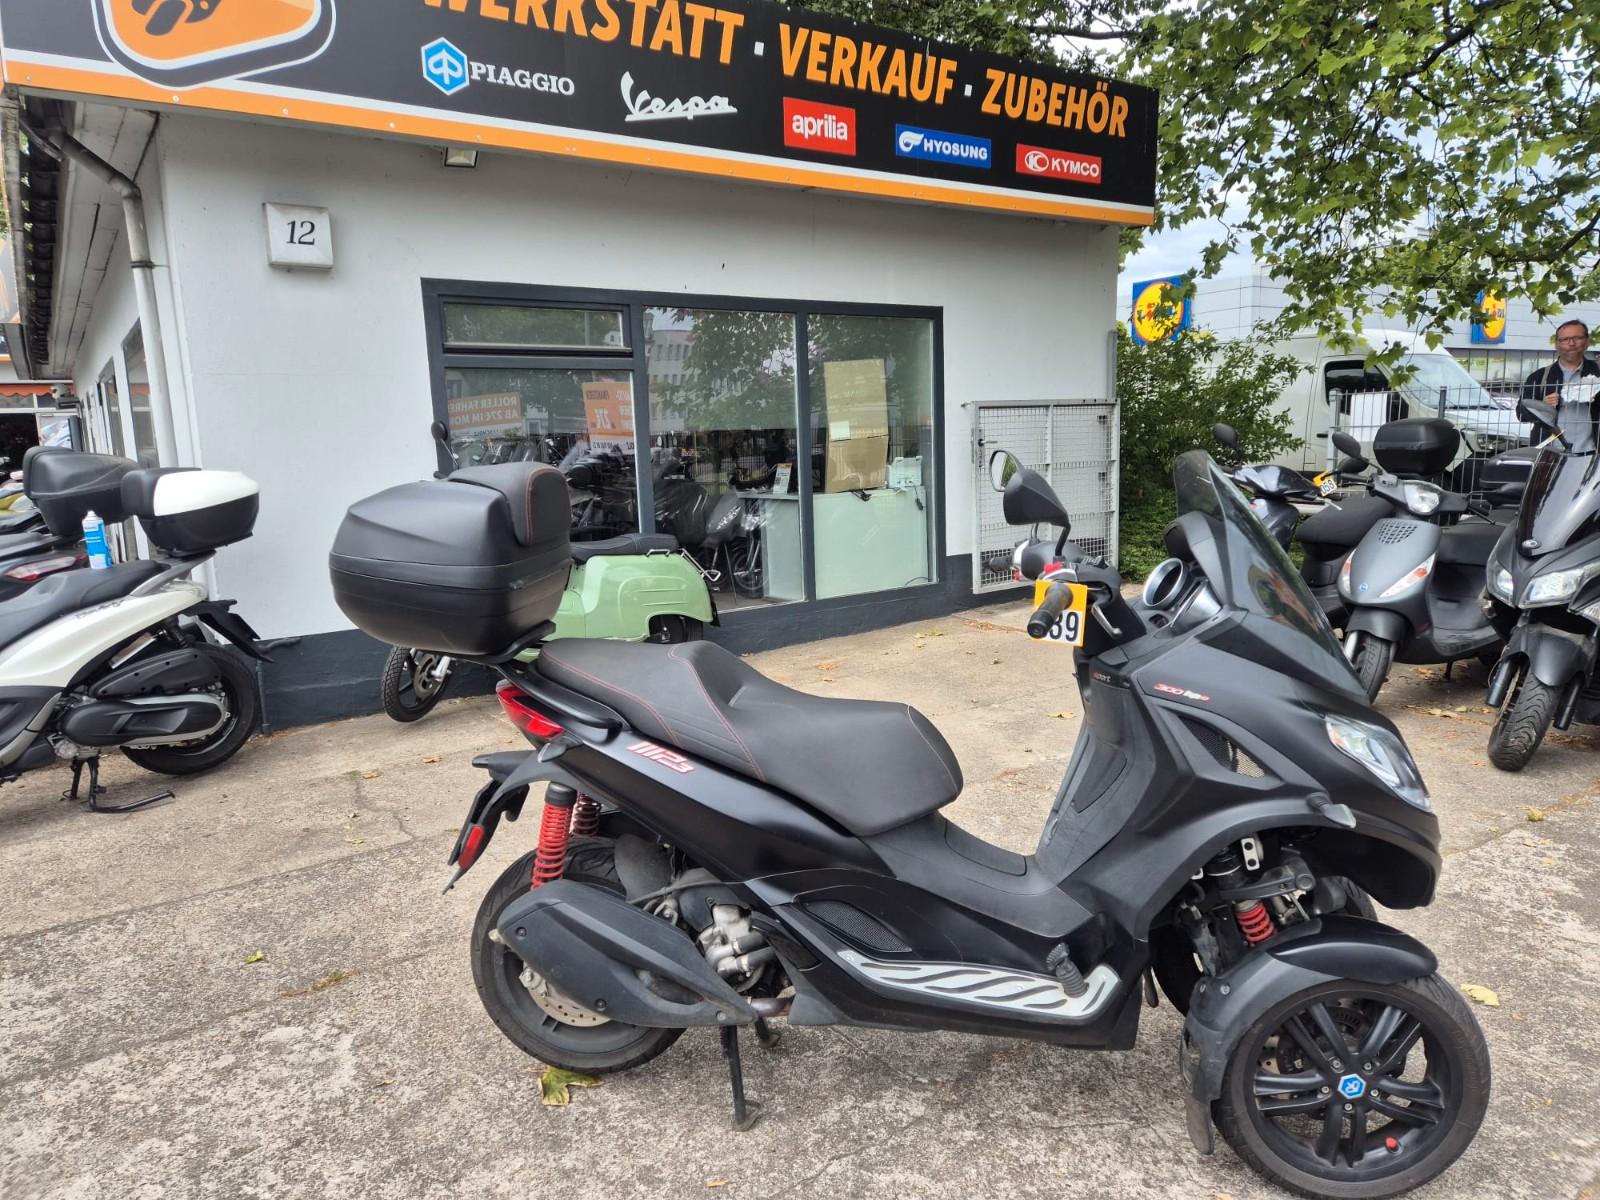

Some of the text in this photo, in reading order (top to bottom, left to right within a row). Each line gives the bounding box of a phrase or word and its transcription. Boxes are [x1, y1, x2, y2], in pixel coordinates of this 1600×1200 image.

[423, 0, 1129, 138] RKSTATT VERKAUF ZUBEHÖR
[469, 61, 575, 96] PIAGGIO
[620, 71, 738, 122] Vespa
[792, 113, 848, 141] aprilia
[923, 138, 988, 161] HYOSUNG
[1051, 157, 1100, 178] KYMCO
[286, 219, 316, 246] 12
